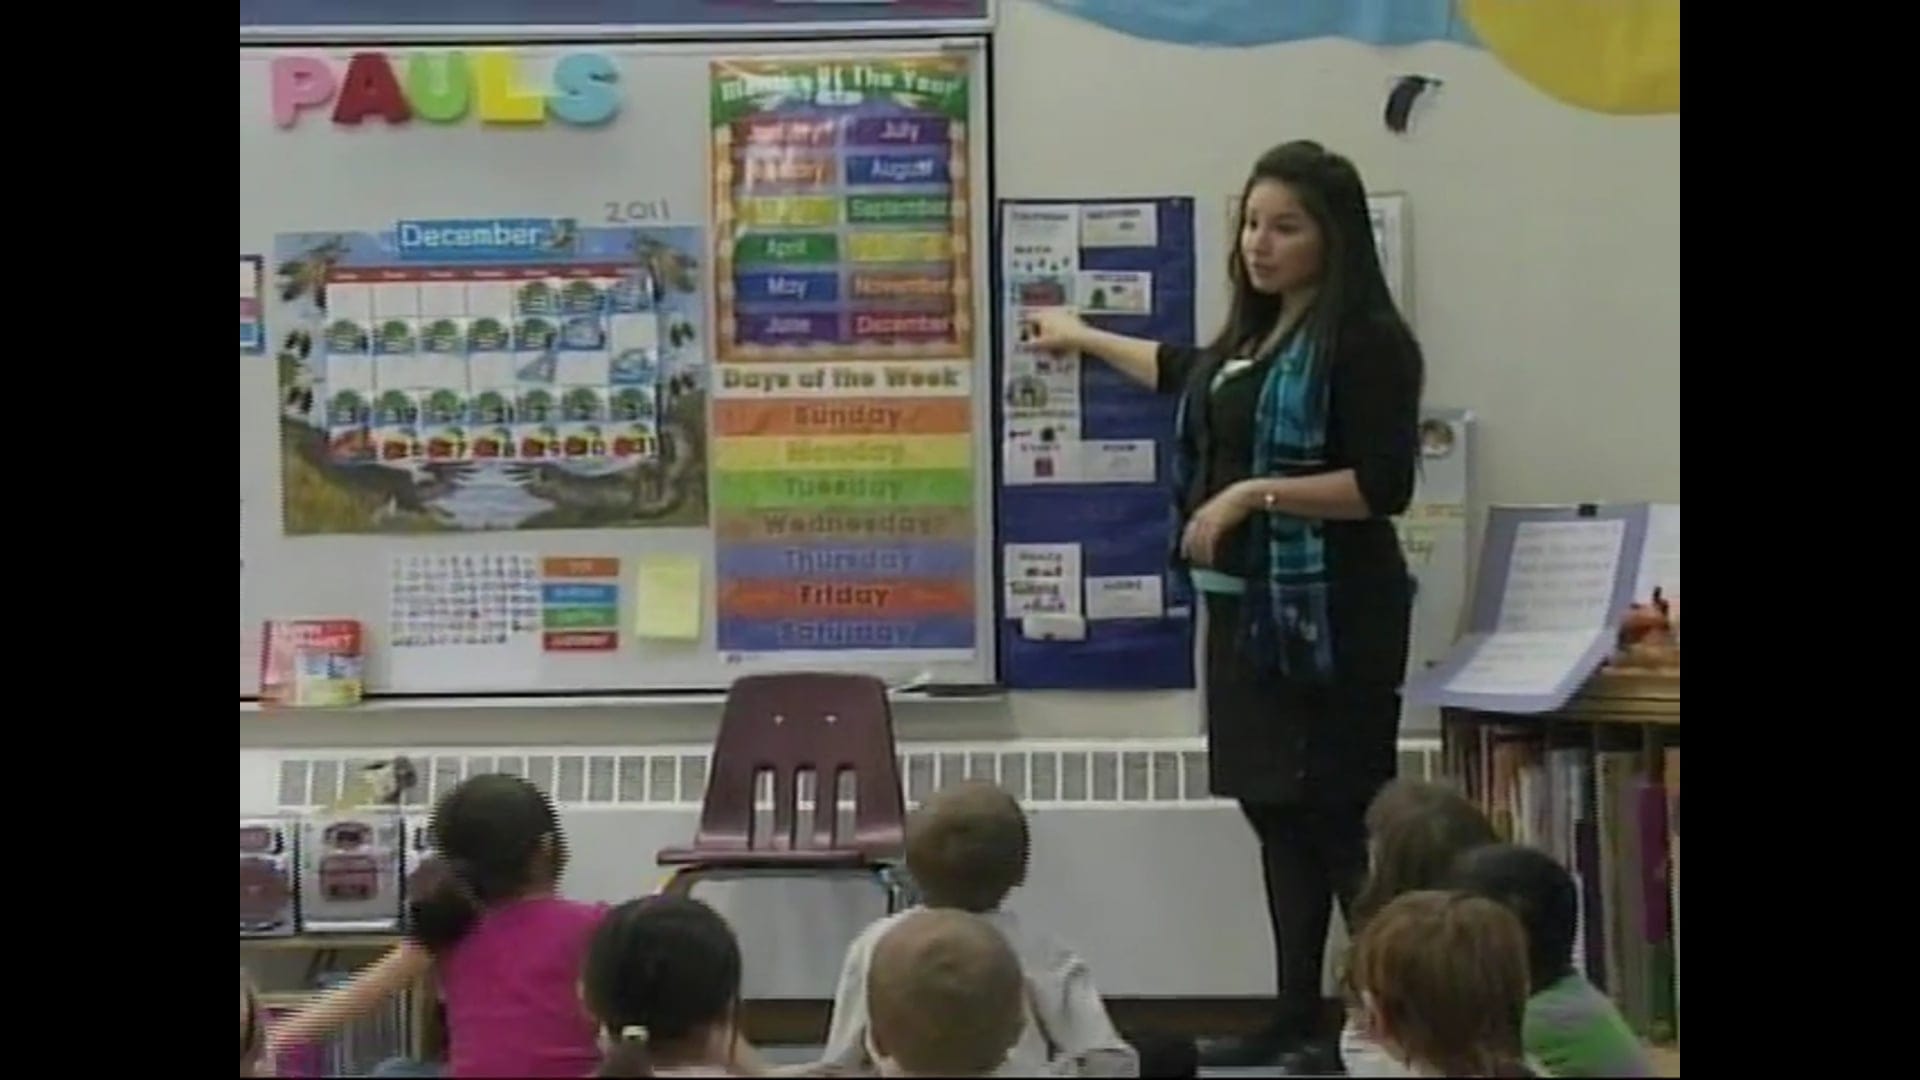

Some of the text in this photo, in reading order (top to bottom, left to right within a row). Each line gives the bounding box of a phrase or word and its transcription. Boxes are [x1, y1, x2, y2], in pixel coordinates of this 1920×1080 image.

[270, 49, 620, 129] PAULS
[853, 64, 888, 88] The
[903, 70, 962, 97] Year
[880, 120, 920, 141] July
[871, 158, 934, 179] August
[605, 199, 669, 222] 2011
[853, 198, 949, 218] September
[401, 222, 542, 248] December
[766, 238, 807, 258] April
[767, 275, 949, 297] May November
[765, 316, 950, 335] June December
[721, 367, 960, 391] Days of the Week
[794, 404, 902, 428] Sunday
[785, 440, 904, 464] Monday
[785, 476, 904, 500] Tuesday
[764, 513, 934, 535] Wednesday
[785, 550, 913, 574] Thursday
[800, 584, 891, 606] Friday
